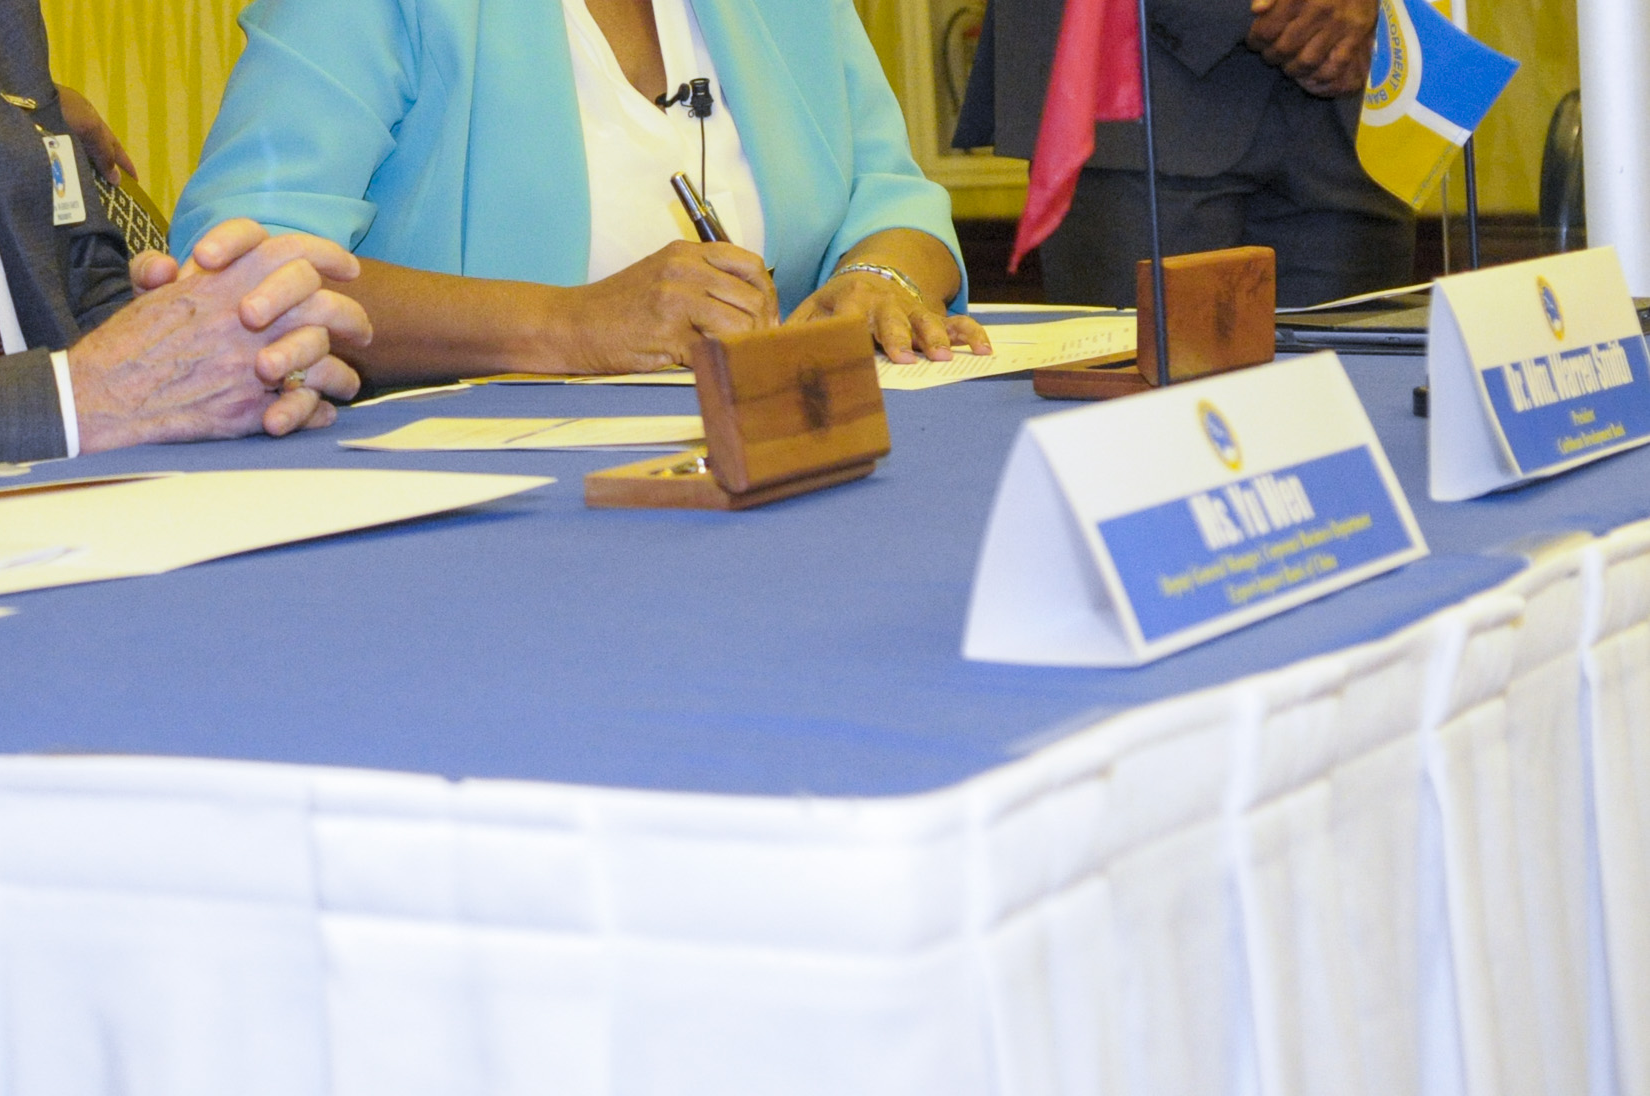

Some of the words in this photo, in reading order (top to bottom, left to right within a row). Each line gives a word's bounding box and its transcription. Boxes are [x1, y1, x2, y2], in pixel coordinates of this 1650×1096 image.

[1550, 353, 1601, 401] Warren
[1591, 340, 1634, 390] Smith
[1253, 472, 1316, 532] Wen
